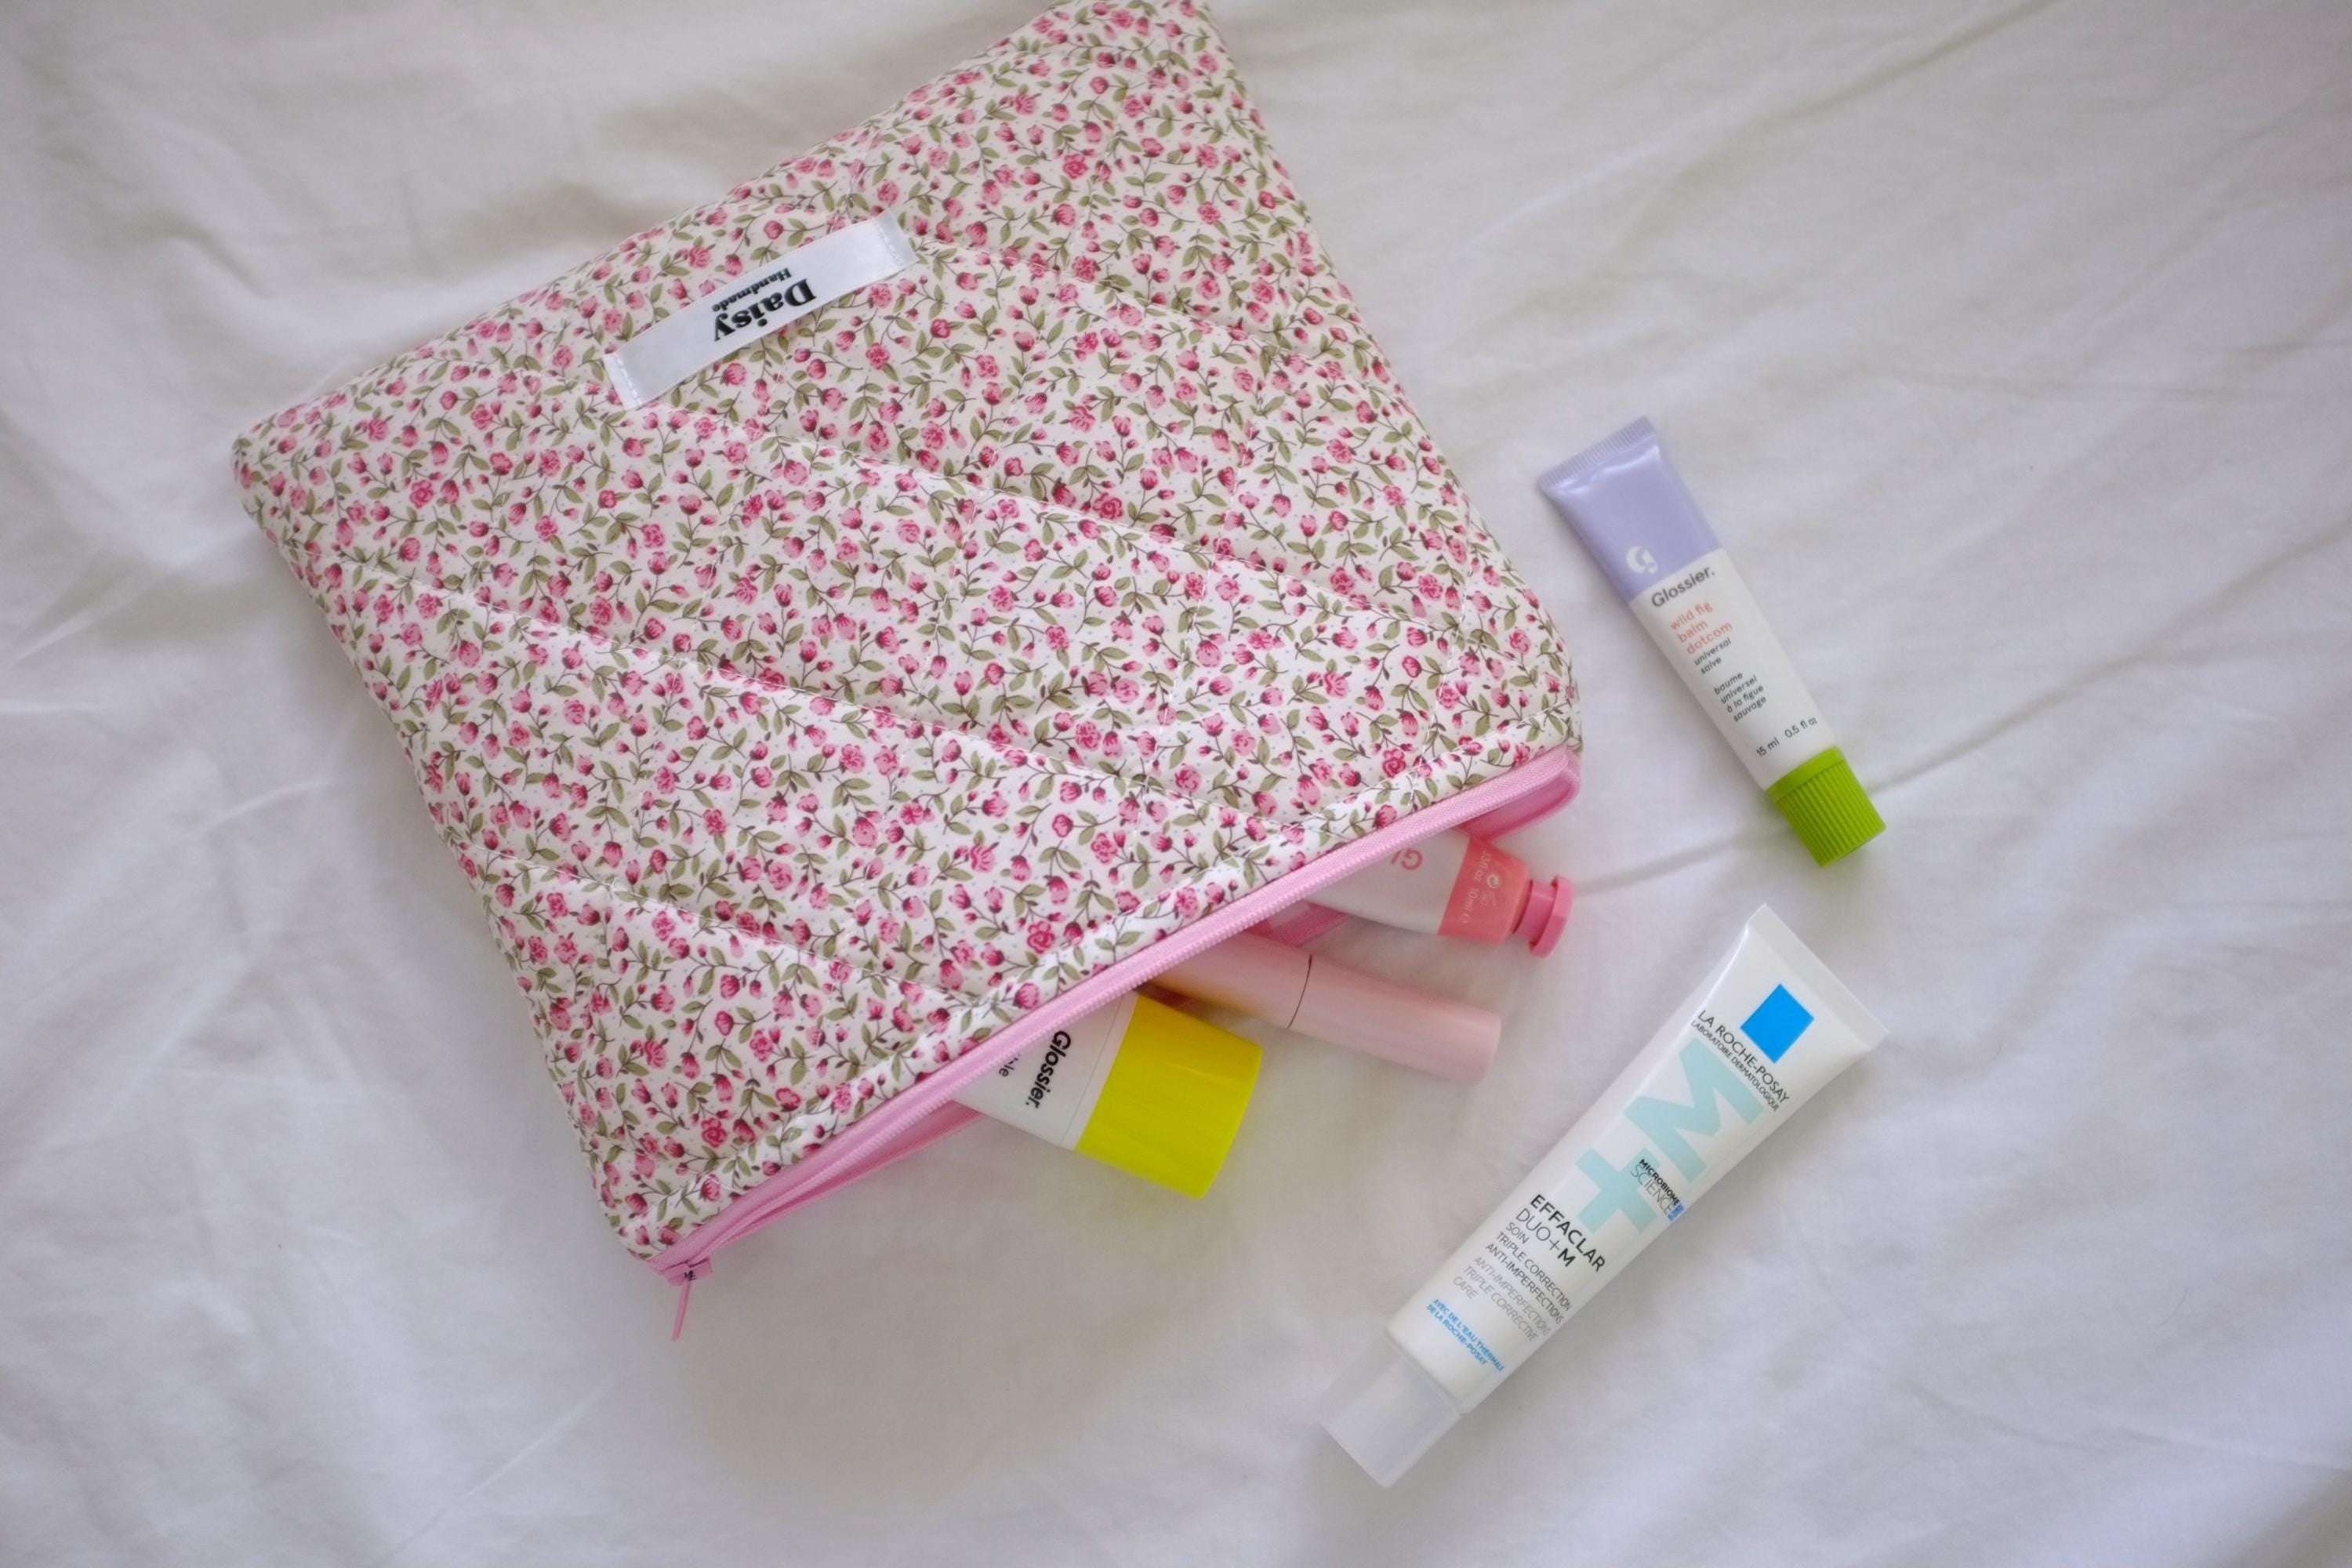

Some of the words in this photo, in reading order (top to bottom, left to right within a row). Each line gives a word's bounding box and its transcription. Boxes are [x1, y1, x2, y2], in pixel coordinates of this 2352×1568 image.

[712, 267, 792, 312] Handmade
[713, 278, 816, 342] Daisy
[1651, 566, 1715, 608] Glossier.
[1670, 609, 1695, 630] wild
[1695, 601, 1713, 616] fig
[1677, 619, 1708, 644] balm
[1686, 621, 1733, 655] dotcom
[1694, 637, 1732, 666] universal
[1700, 657, 1722, 675] salve
[1714, 673, 1743, 695] baume
[1721, 674, 1757, 704] universel
[1733, 699, 1742, 708] la
[1743, 685, 1763, 702] figue
[1733, 696, 1766, 722] sauvage
[1756, 746, 1767, 757] 15
[1767, 737, 1780, 750] ml
[1784, 724, 1800, 738] 0.5
[1800, 720, 1808, 730] fl
[1808, 717, 1817, 726] oz
[1025, 1030, 1072, 1109] Glossier.
[1690, 1020, 1733, 1058] LABORATOIRE
[1731, 1056, 1780, 1112] DERMATOLOGIQUE
[1698, 1010, 1715, 1028] LA
[1715, 1025, 1790, 1103] ROCHE-POSAY
[1630, 1163, 1676, 1216] SCIENCE
[1639, 1158, 1680, 1206] MICROBIOME
[1505, 1221, 1530, 1244] SOIN
[1530, 1193, 1606, 1272] EFFACLAR
[1453, 1276, 1478, 1299] CARE
[1486, 1243, 1564, 1325] ANTI-IMPERFECTIONS
[1496, 1231, 1526, 1262] TRIPLE
[1524, 1258, 1572, 1312] CORRECTION
[1463, 1265, 1494, 1295] TRIPLE
[1490, 1292, 1538, 1343] CORRECTIVE
[1474, 1256, 1552, 1337] ANTI-IMPERFECTIONS
[1427, 1304, 1436, 1314] DE
[1435, 1311, 1444, 1322] LA
[1443, 1319, 1488, 1365] ROCHE-POSAY
[1432, 1298, 1450, 1315] AVEC
[1448, 1312, 1459, 1324] DE
[1476, 1340, 1504, 1372] THERMALE
